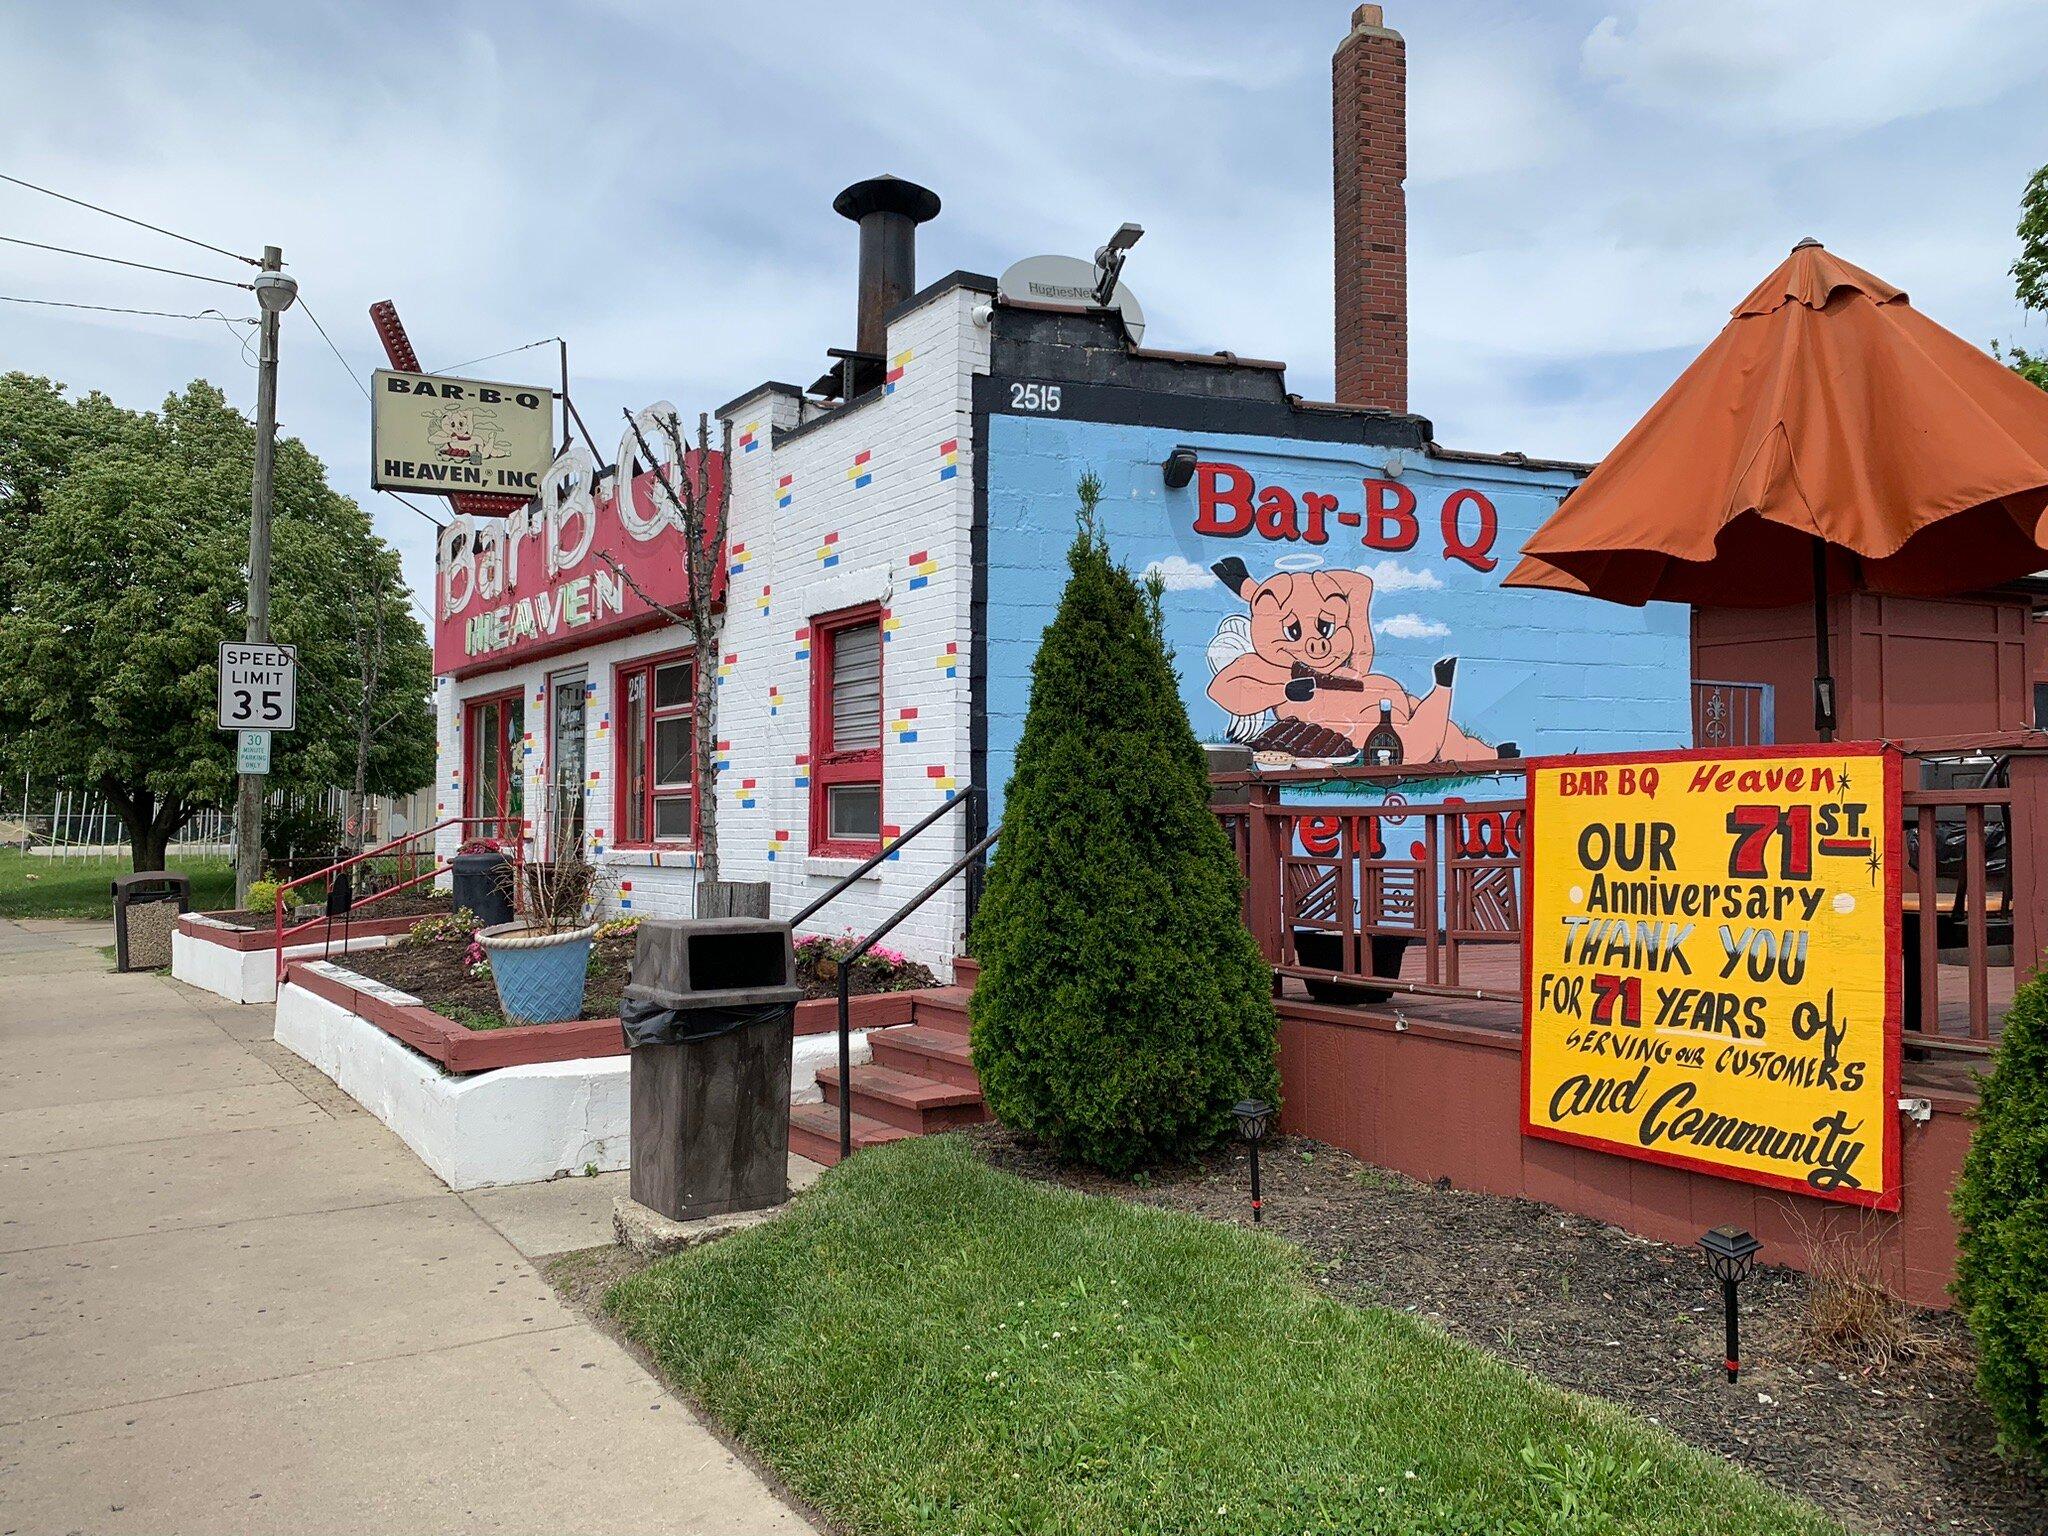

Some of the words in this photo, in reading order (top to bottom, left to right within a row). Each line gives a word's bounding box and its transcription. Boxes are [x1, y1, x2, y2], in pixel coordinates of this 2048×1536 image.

[387, 377, 540, 410] BAR-B-Q
[1010, 382, 1062, 412] 2515
[465, 563, 624, 657] HEAVEN
[226, 650, 289, 667] SPEED
[232, 670, 283, 685] LIMIT
[232, 690, 282, 720] 35
[243, 747, 265, 755] MINUTE
[247, 734, 262, 746] 30
[1559, 771, 1609, 797] BAR
[1617, 767, 1660, 800] BQ
[1686, 764, 1836, 794] Heaven
[1577, 822, 1677, 872] OUR
[1586, 873, 1826, 922] Anniversary
[1562, 916, 1696, 976] THANK
[1718, 925, 1810, 986] YOU
[1539, 973, 1585, 1020] FOR
[1590, 973, 1642, 1028] 71
[1654, 987, 1768, 1040] YEARS
[1791, 987, 1847, 1063] of
[1565, 1028, 1673, 1065] SERVING
[1676, 1046, 1706, 1067] OUR
[1715, 1045, 1867, 1092] CUSTOMERS
[1549, 1065, 1651, 1123] and
[1638, 1081, 1866, 1193] Community
